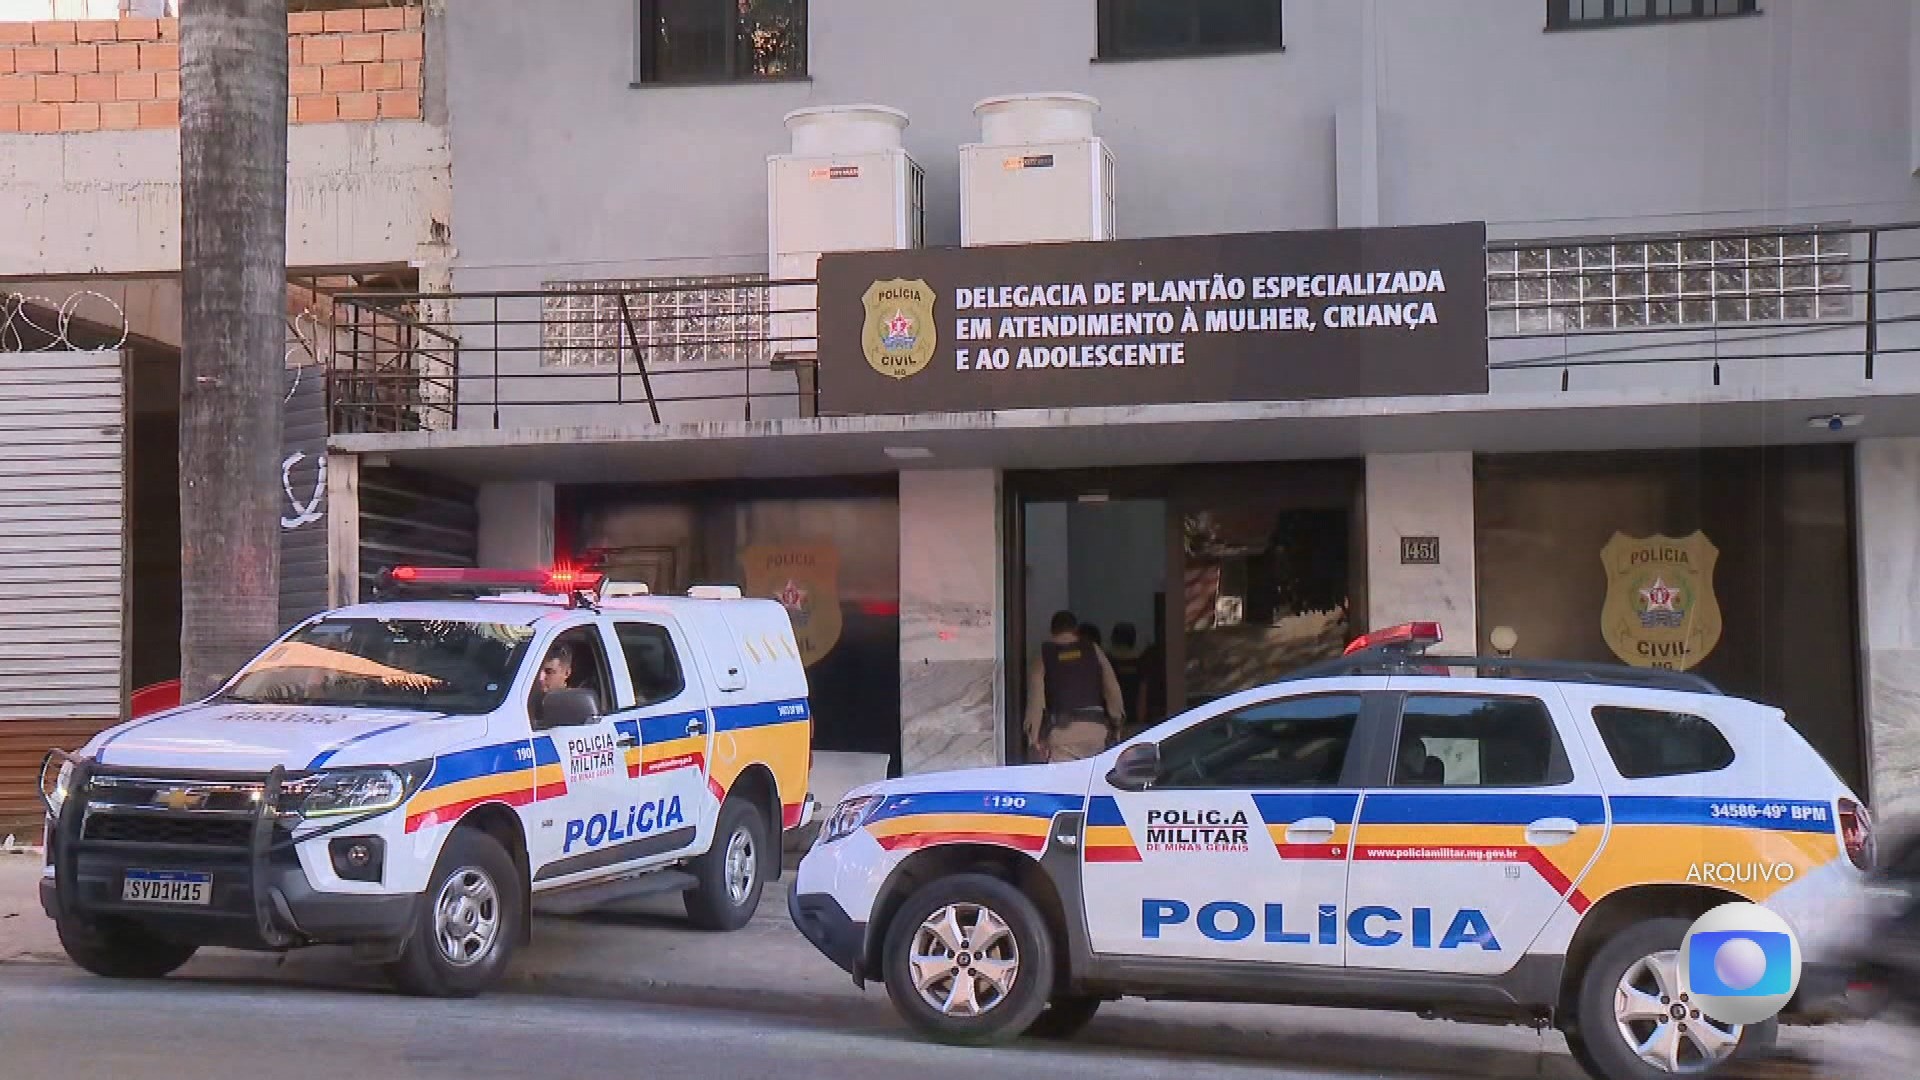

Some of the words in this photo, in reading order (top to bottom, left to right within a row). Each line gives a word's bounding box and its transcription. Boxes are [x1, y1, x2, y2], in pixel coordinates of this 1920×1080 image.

[956, 283, 1087, 310] DELEGACIA
[1093, 282, 1125, 304] DE
[1131, 273, 1246, 304] PLANTÃO
[1252, 269, 1446, 300] ESPECIALIZADA
[956, 318, 991, 340] EM
[998, 312, 1174, 338] ATENDIMENTO
[1180, 306, 1199, 333] À
[1205, 306, 1317, 332] MULHER,
[1323, 302, 1439, 331] CRIANÇA
[881, 355, 917, 366] CIVIL
[956, 349, 969, 370] E
[975, 348, 1010, 370] AO
[1015, 342, 1184, 369] ADOLESCENTE
[1637, 641, 1690, 657] CIVIL
[516, 747, 533, 761] 190
[570, 752, 614, 775] MILITAR
[991, 795, 1026, 809] 190
[1791, 805, 1827, 821] BPM
[1147, 829, 1248, 843] MILITAR
[1367, 847, 1519, 861] www.policiamilitar.mg.gov.br
[131, 881, 202, 901] SYD1H15
